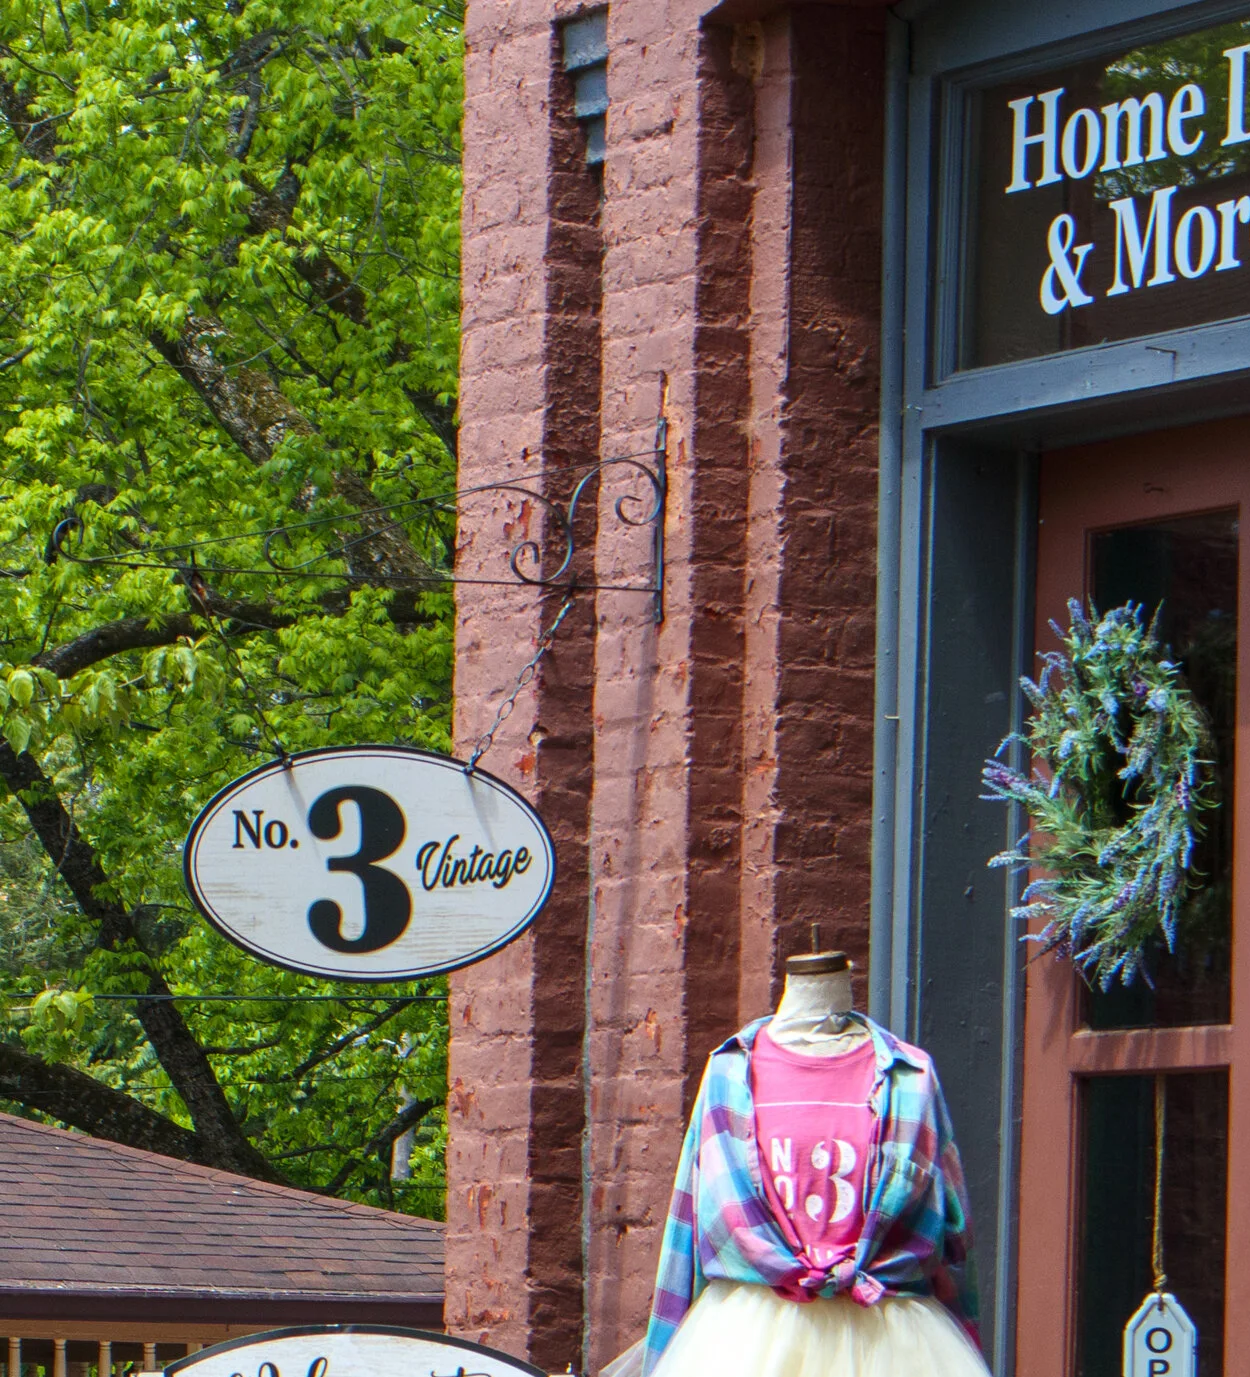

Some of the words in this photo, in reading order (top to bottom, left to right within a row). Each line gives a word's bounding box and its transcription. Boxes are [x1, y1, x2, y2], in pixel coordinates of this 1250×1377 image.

[1005, 82, 1206, 194] Home
[1040, 213, 1093, 315] &
[232, 809, 300, 850] No.
[308, 784, 413, 953] 3
[416, 834, 532, 891] Vintage
[805, 1139, 857, 1223] 3
